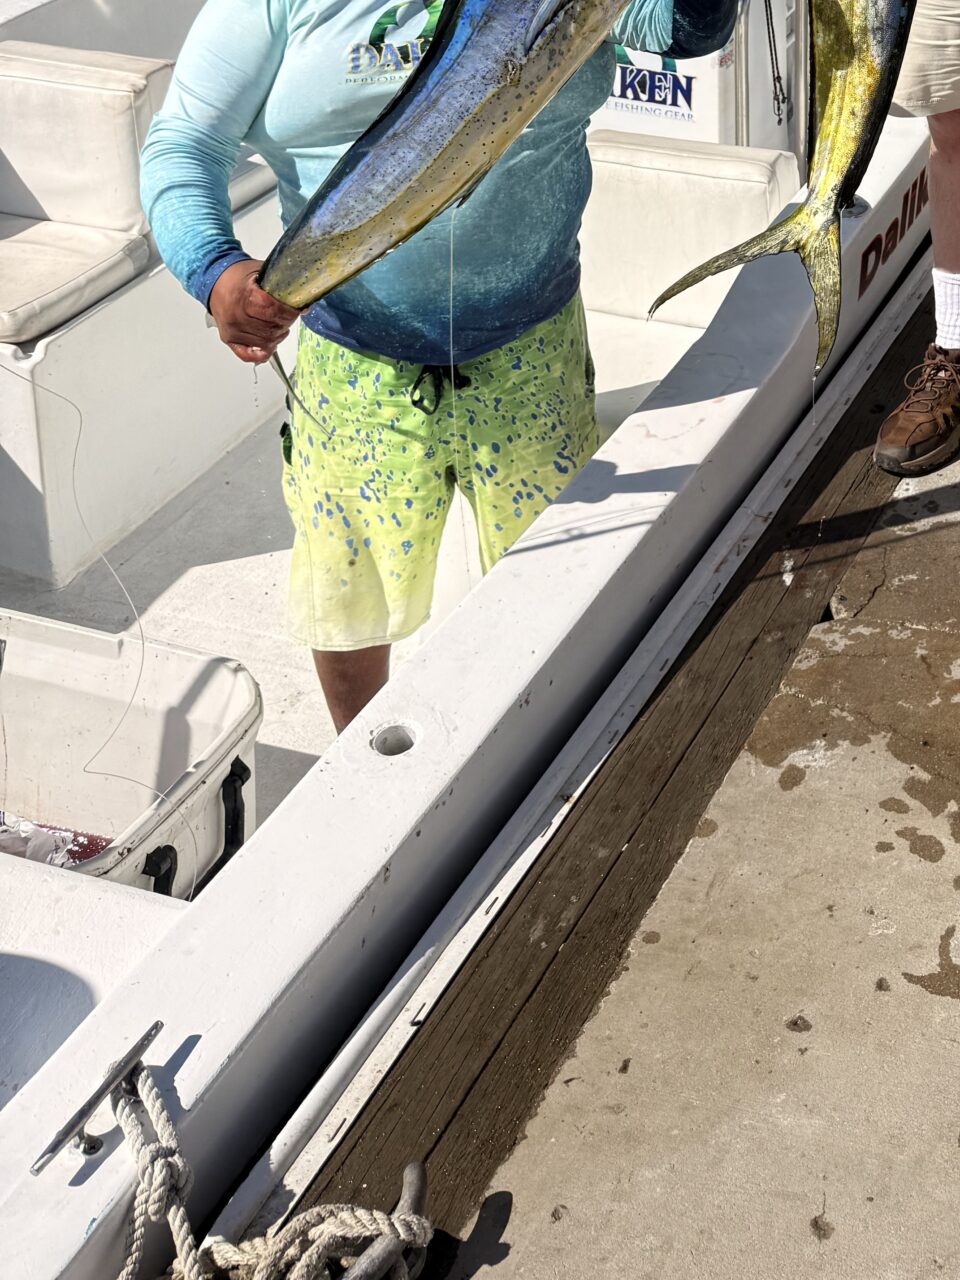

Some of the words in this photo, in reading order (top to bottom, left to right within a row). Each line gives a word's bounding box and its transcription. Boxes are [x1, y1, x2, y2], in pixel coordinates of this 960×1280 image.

[611, 65, 697, 111] KEN
[614, 101, 662, 118] FISHING
[664, 109, 696, 123] GEAR
